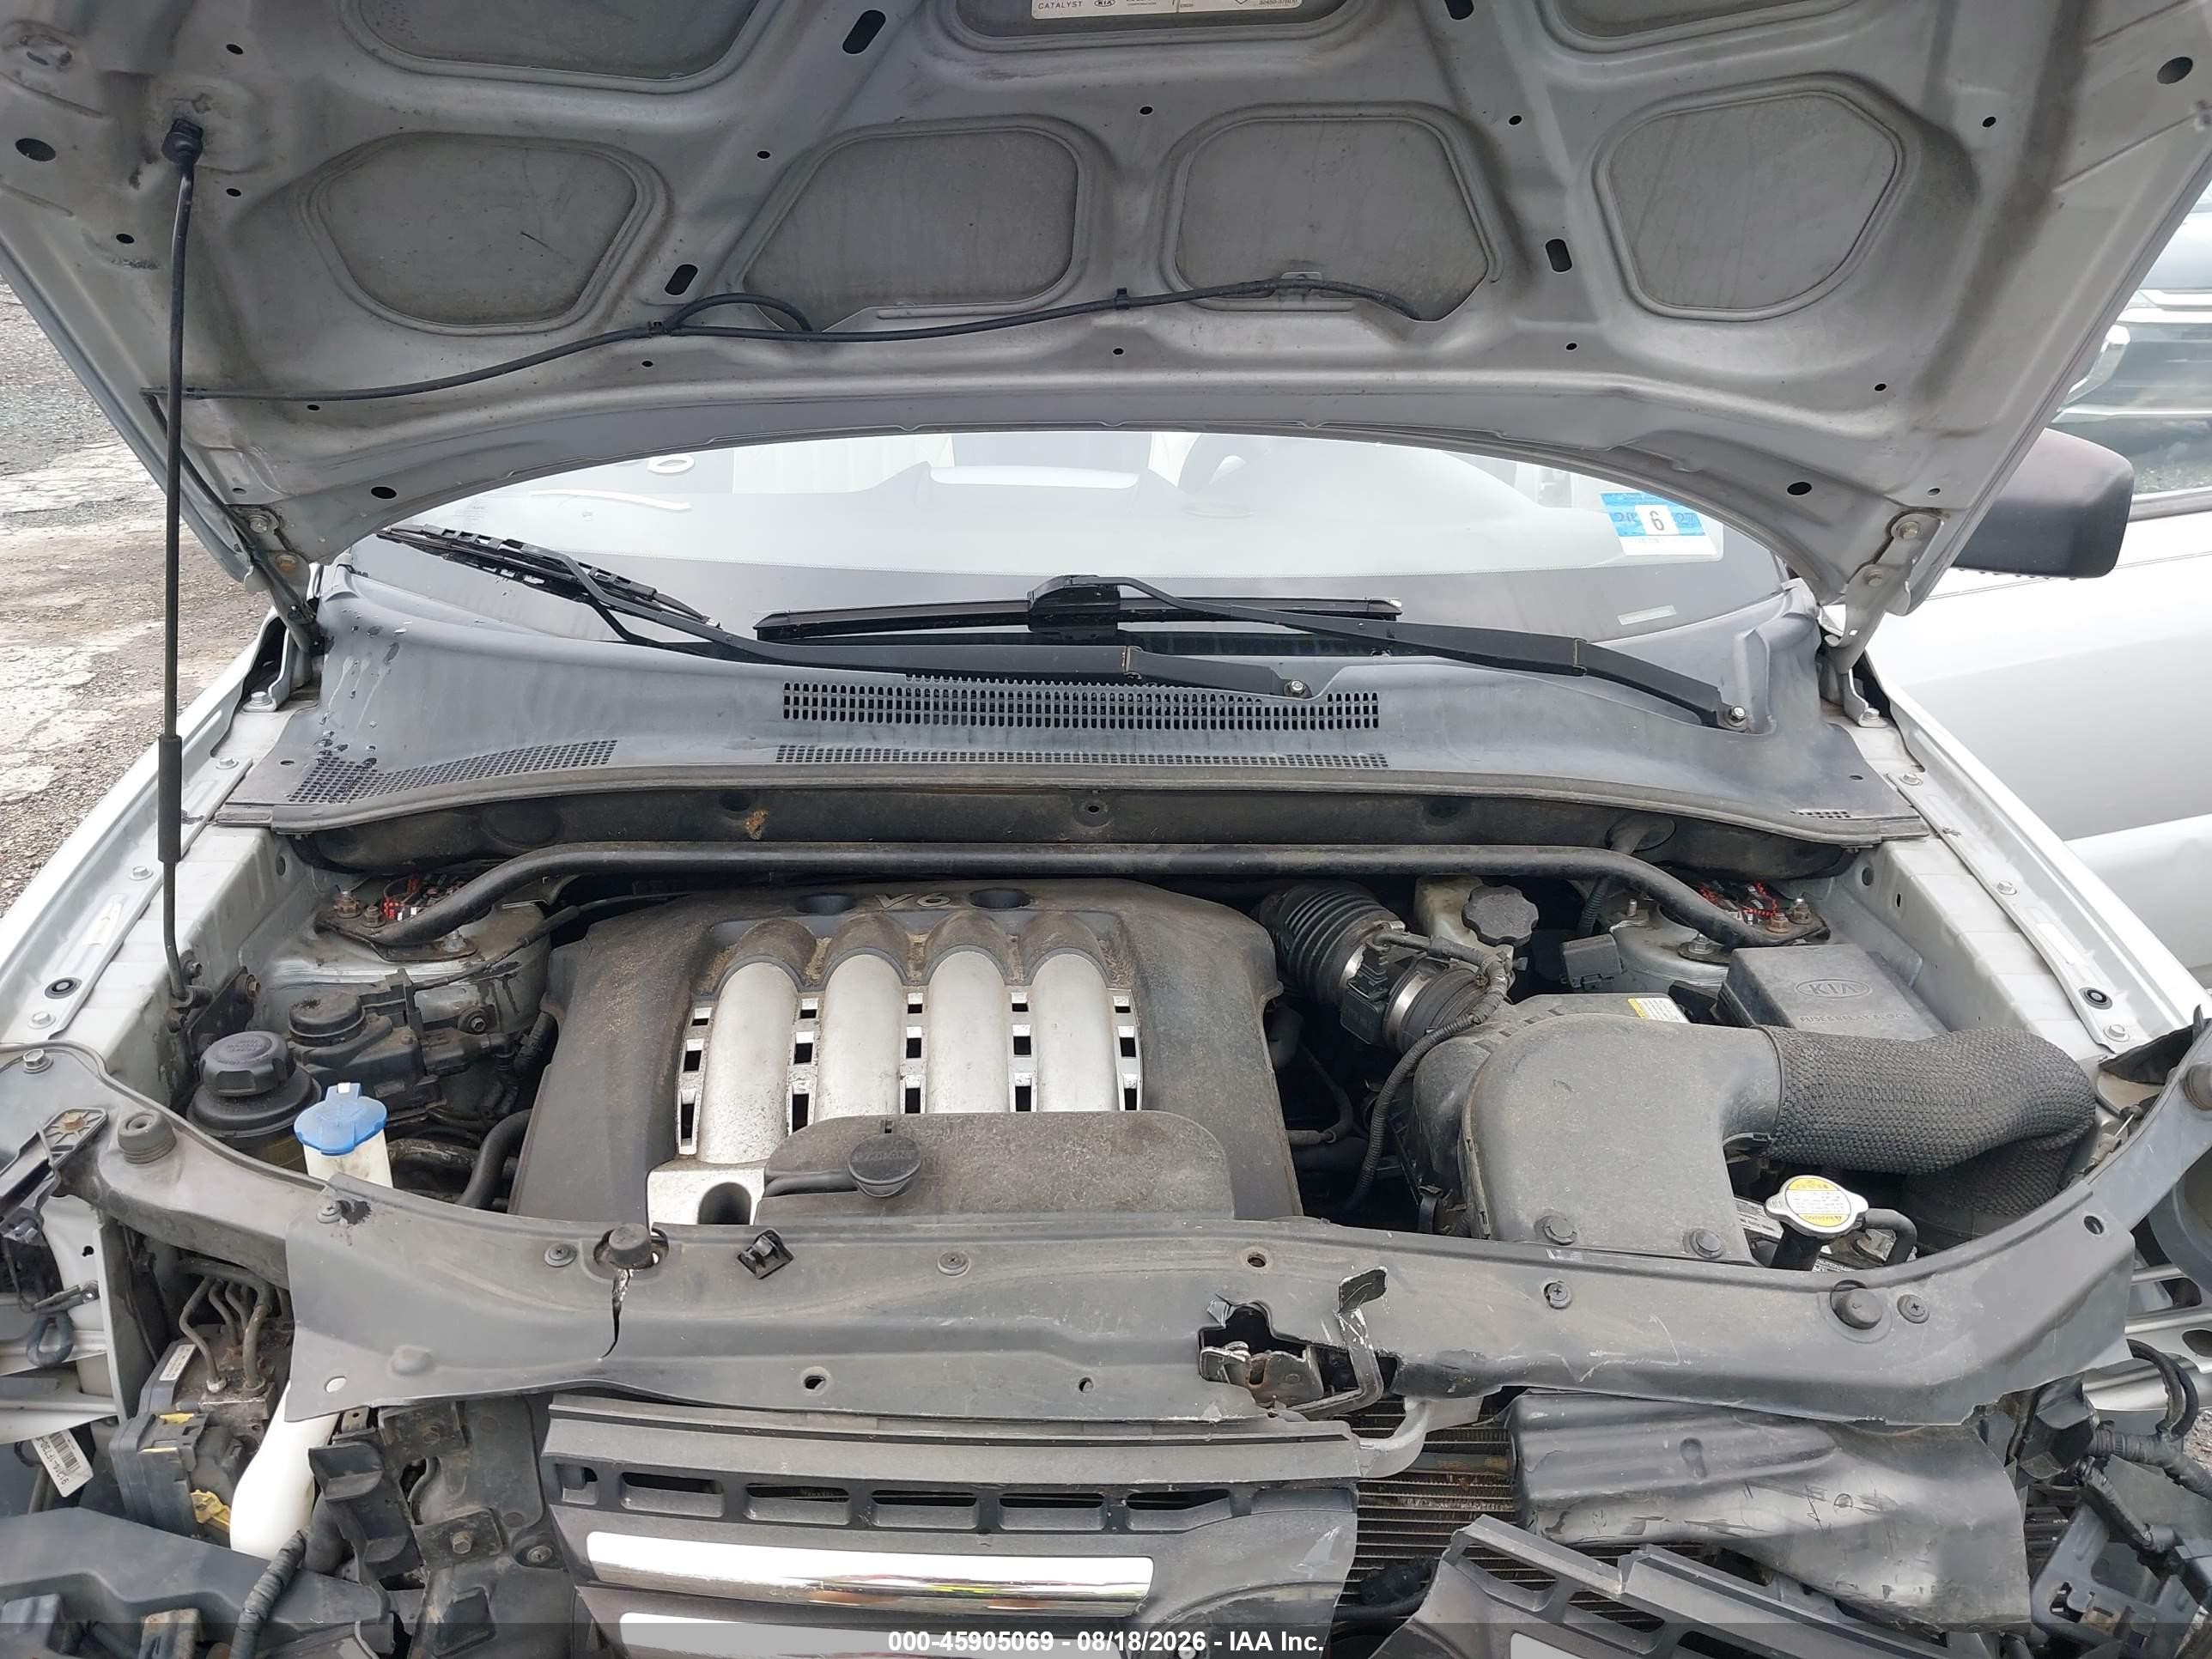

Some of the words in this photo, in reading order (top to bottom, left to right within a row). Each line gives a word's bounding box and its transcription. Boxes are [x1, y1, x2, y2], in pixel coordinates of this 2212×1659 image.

[1037, 1, 1084, 9] CATALYST
[1650, 510, 1665, 531] 6
[874, 892, 951, 908] V6
